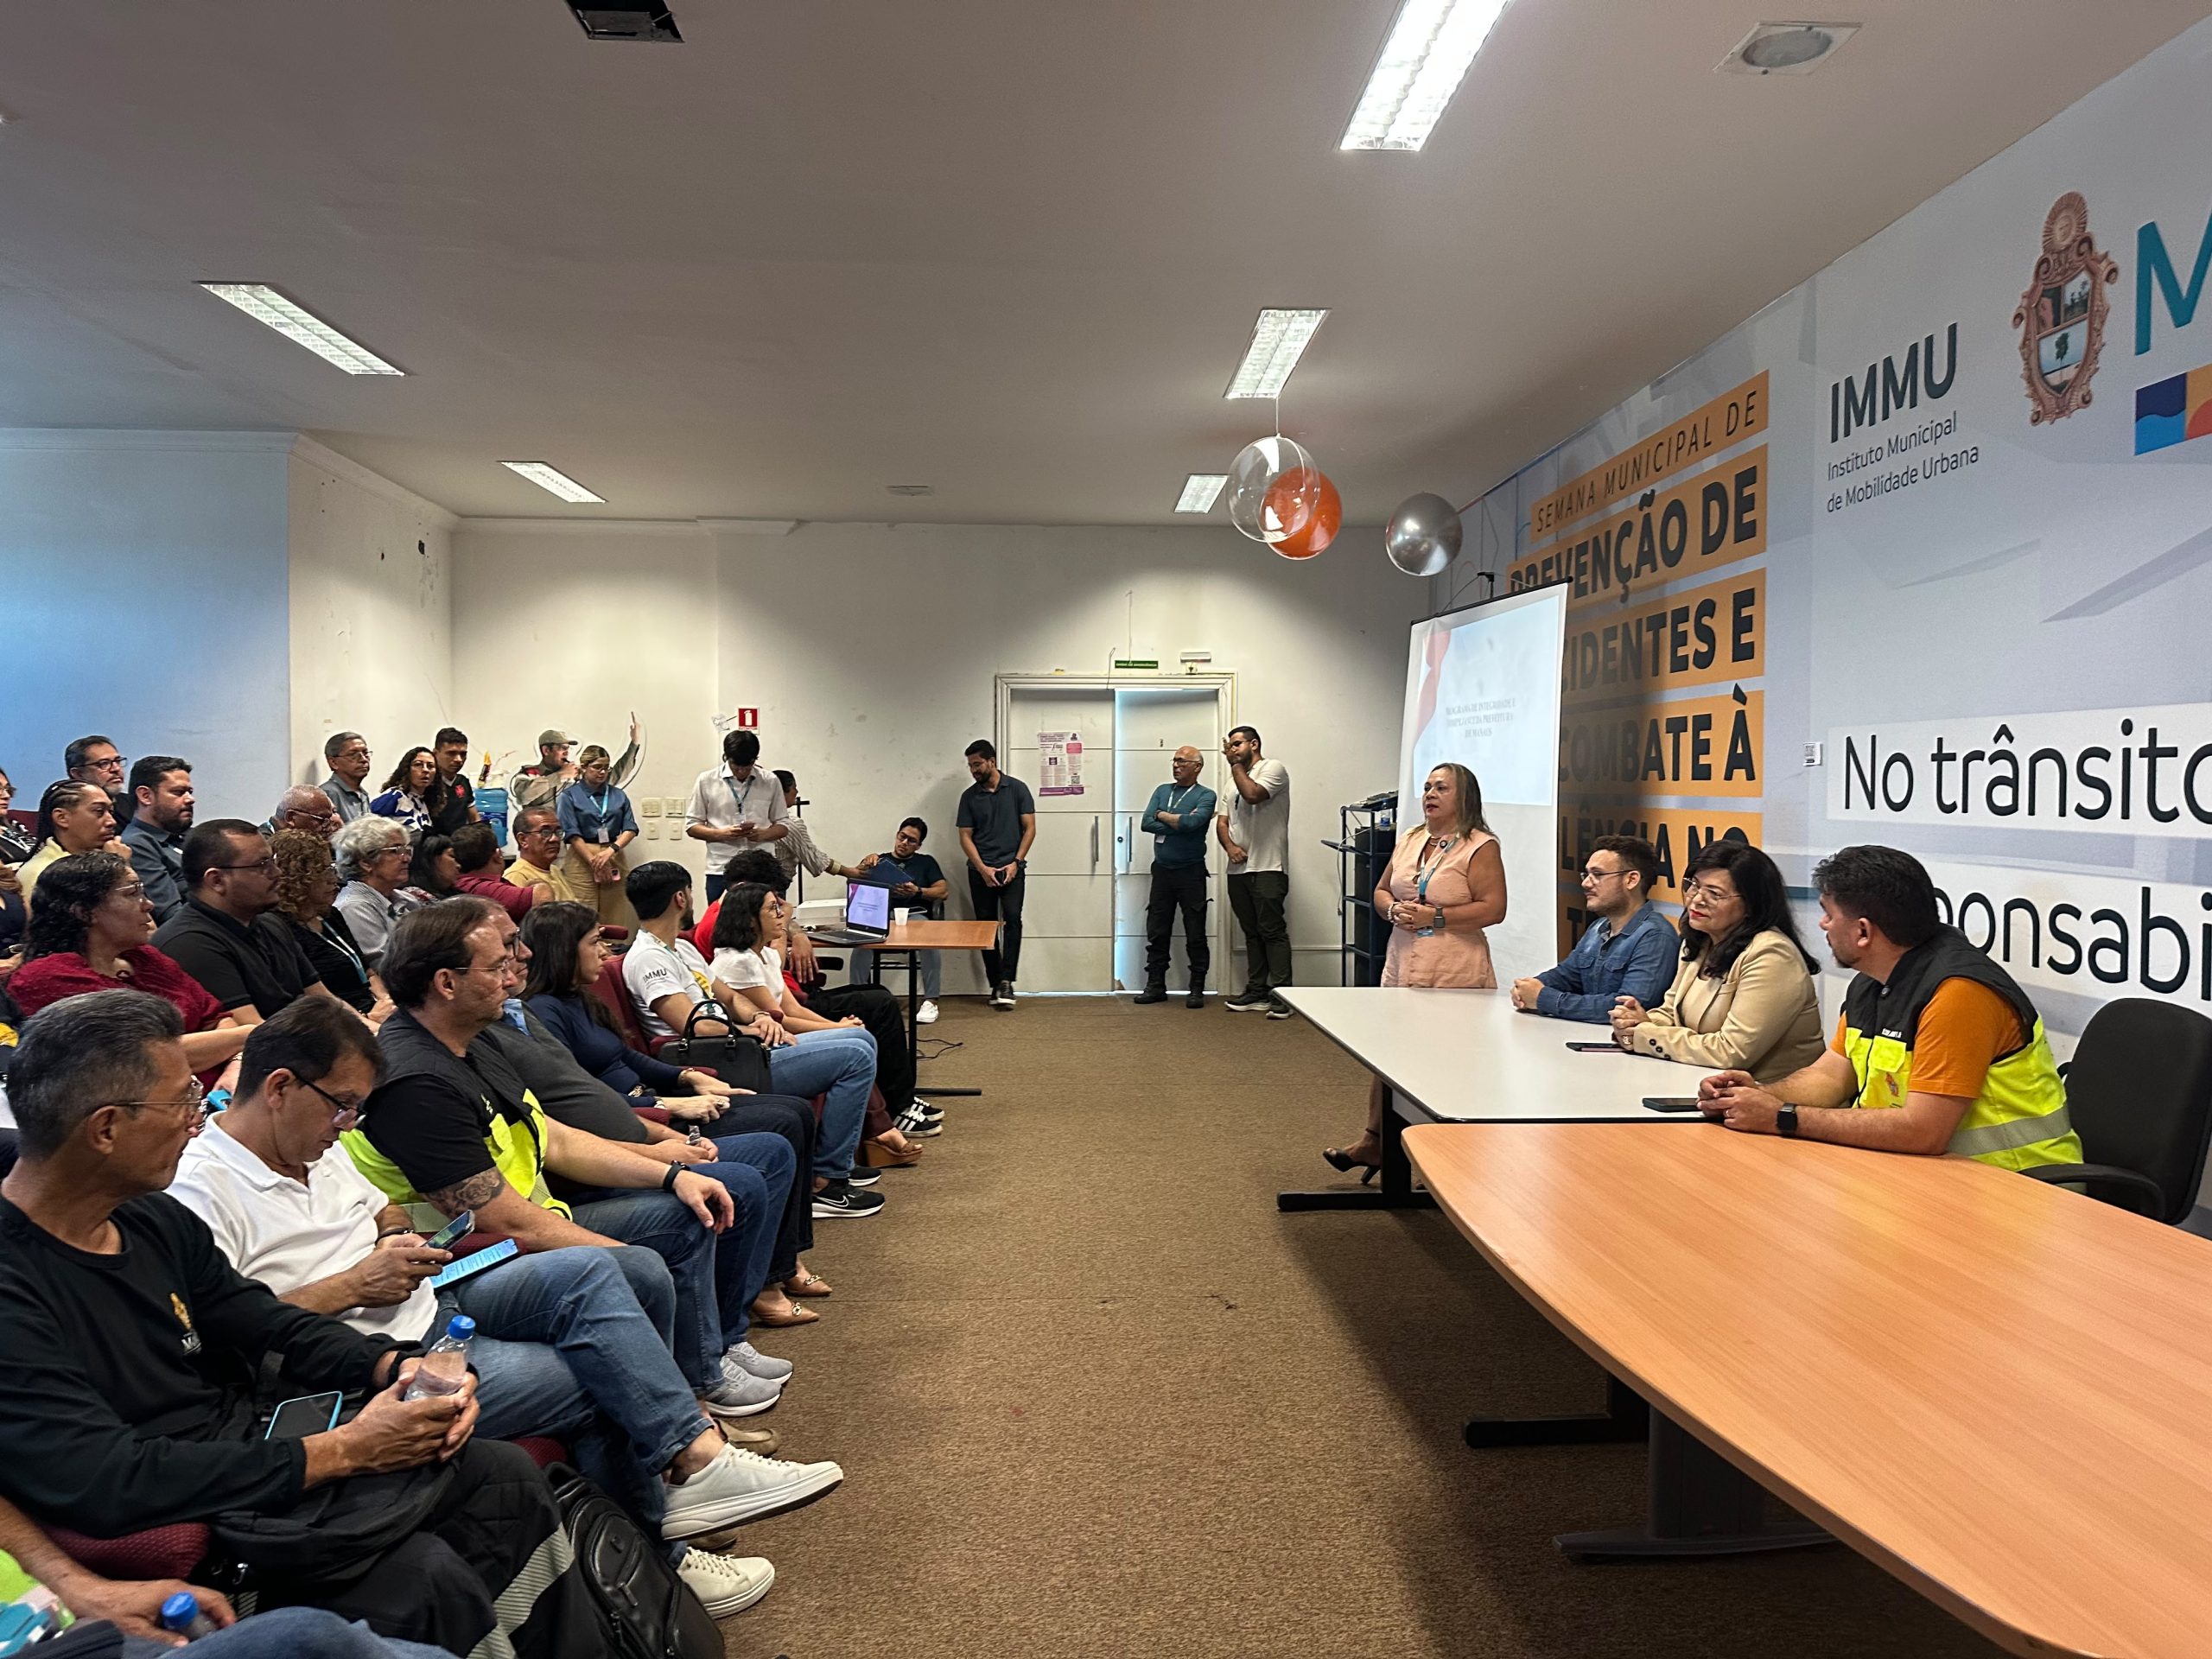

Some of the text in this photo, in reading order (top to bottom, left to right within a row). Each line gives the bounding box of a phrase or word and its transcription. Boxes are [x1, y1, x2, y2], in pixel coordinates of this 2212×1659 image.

[1831, 321, 1958, 443] IMMU
[1536, 390, 1758, 532] SEMANA MUNICIPAL DE
[1827, 410, 1957, 481] Instituto Municipal
[1827, 445, 1980, 513] de Mobilidade Urbana
[1700, 465, 1758, 556] DE
[1732, 587, 1756, 664] E
[1723, 682, 1756, 782] À
[1844, 734, 1914, 812] No
